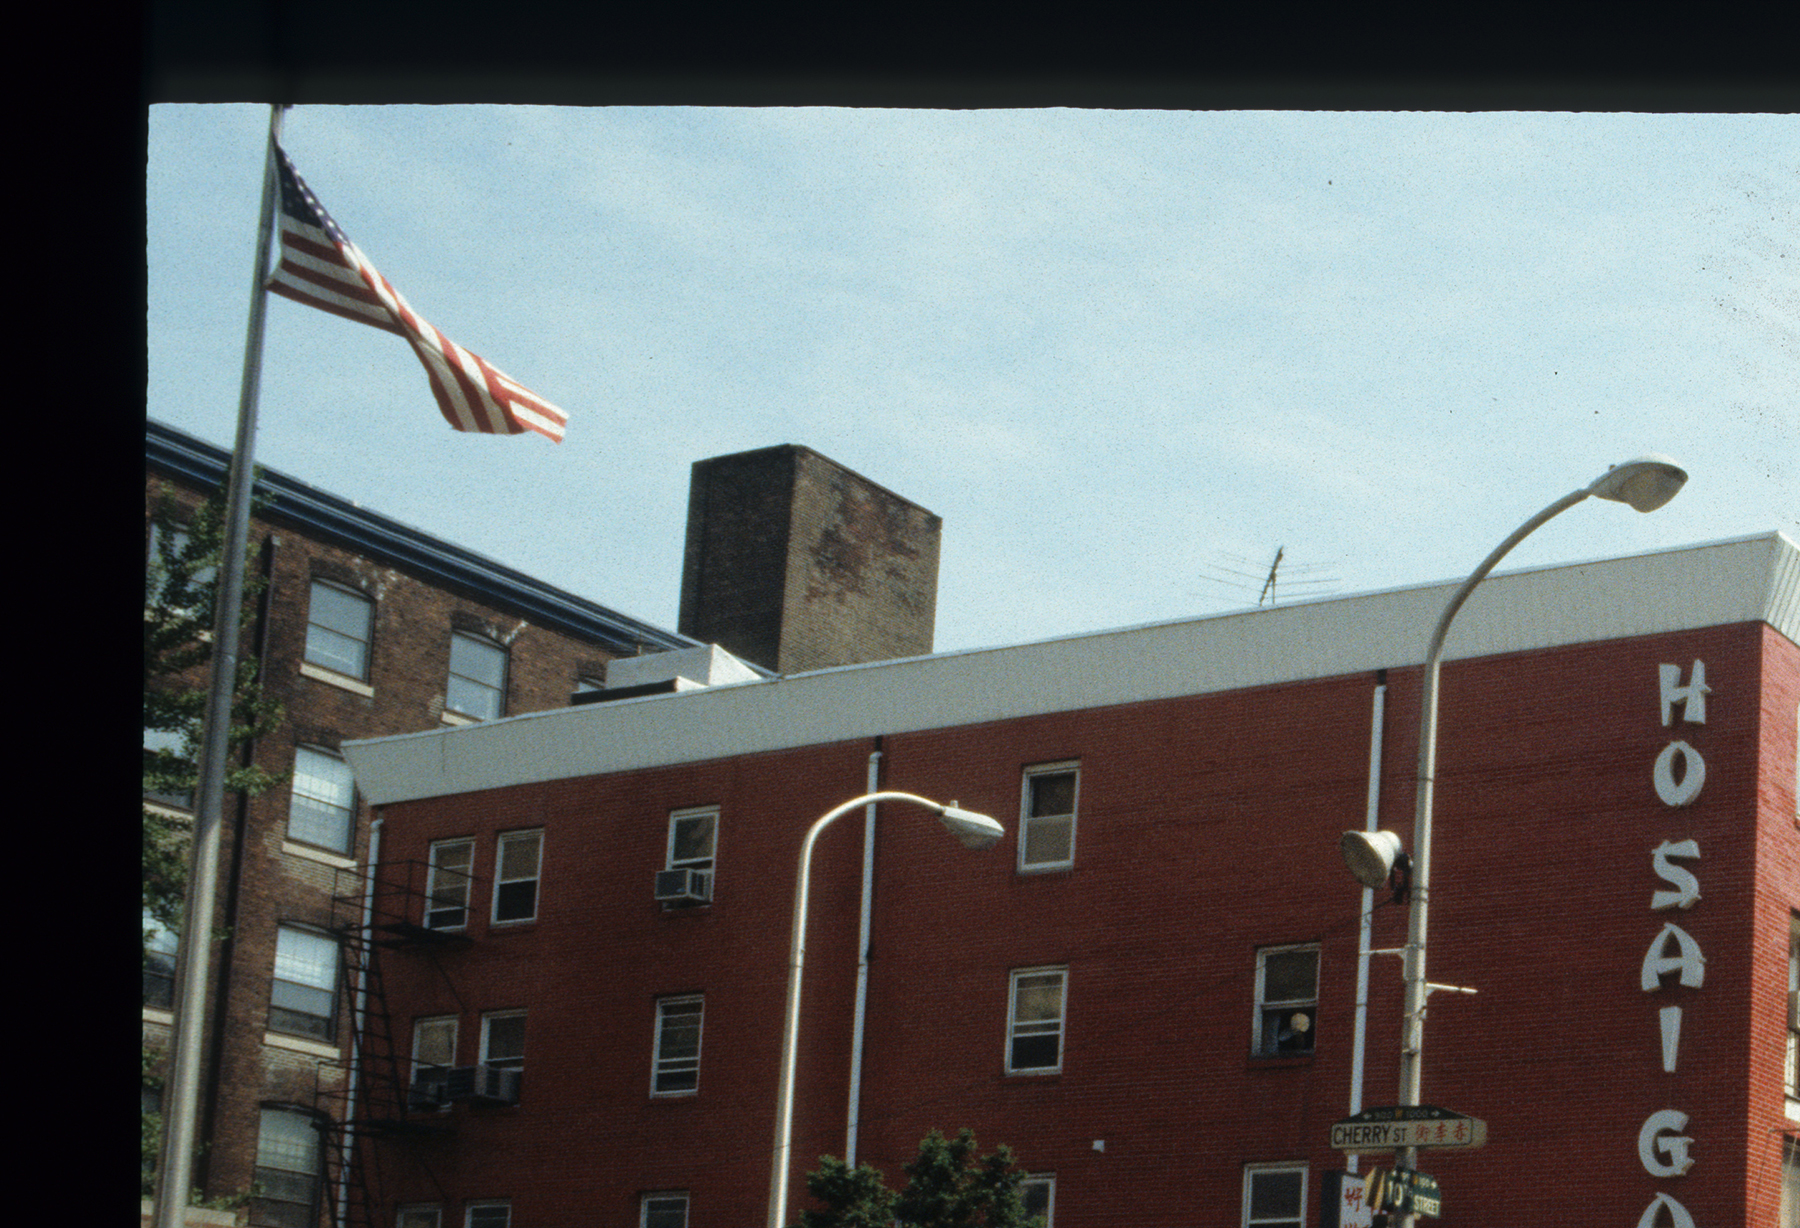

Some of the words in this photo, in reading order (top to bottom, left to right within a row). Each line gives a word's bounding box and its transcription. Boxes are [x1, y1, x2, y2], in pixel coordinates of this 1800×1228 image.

[1653, 659, 1711, 807] HO
[1641, 838, 1707, 1072] SAI
[1333, 1126, 1391, 1145] CHERRY
[1393, 1127, 1407, 1143] ST
[1414, 1194, 1440, 1216] STREET
